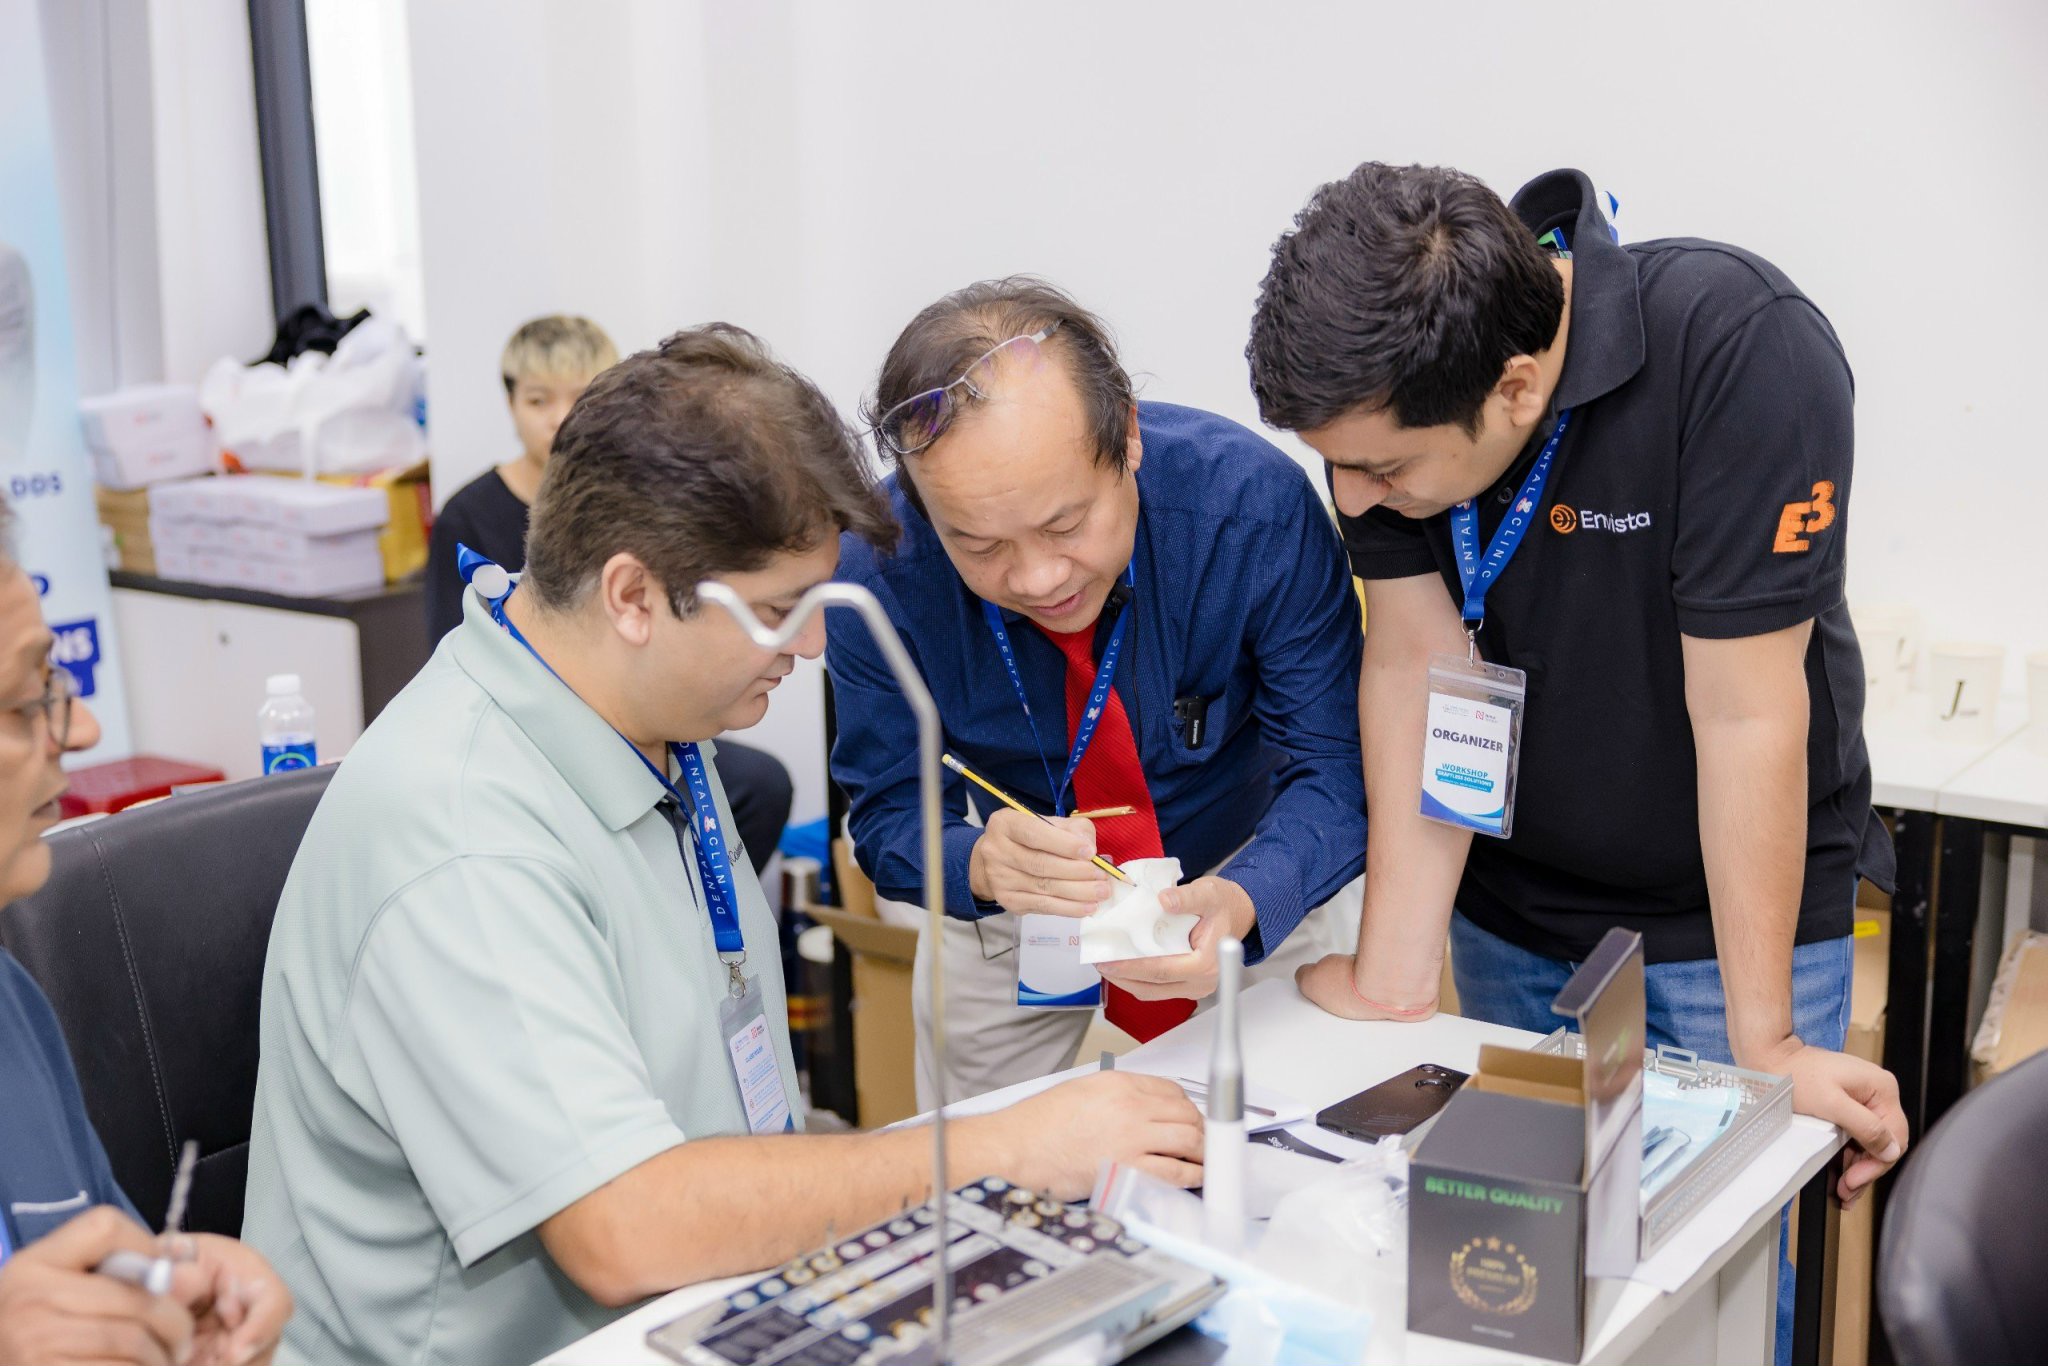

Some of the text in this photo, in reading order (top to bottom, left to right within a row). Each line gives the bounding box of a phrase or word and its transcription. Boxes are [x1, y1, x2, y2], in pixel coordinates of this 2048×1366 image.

[1481, 424, 1566, 578] DENTAL CLINIC
[1460, 513, 1476, 585] ENTAL
[996, 631, 1024, 698] DENTAL
[1095, 638, 1120, 702] CLINIC
[1432, 728, 1503, 753] ORGANIZER
[1441, 763, 1489, 778] WORKSHOP
[679, 742, 730, 905] DENTAL CLINI
[1425, 1176, 1564, 1215] BETTER QUALITY
